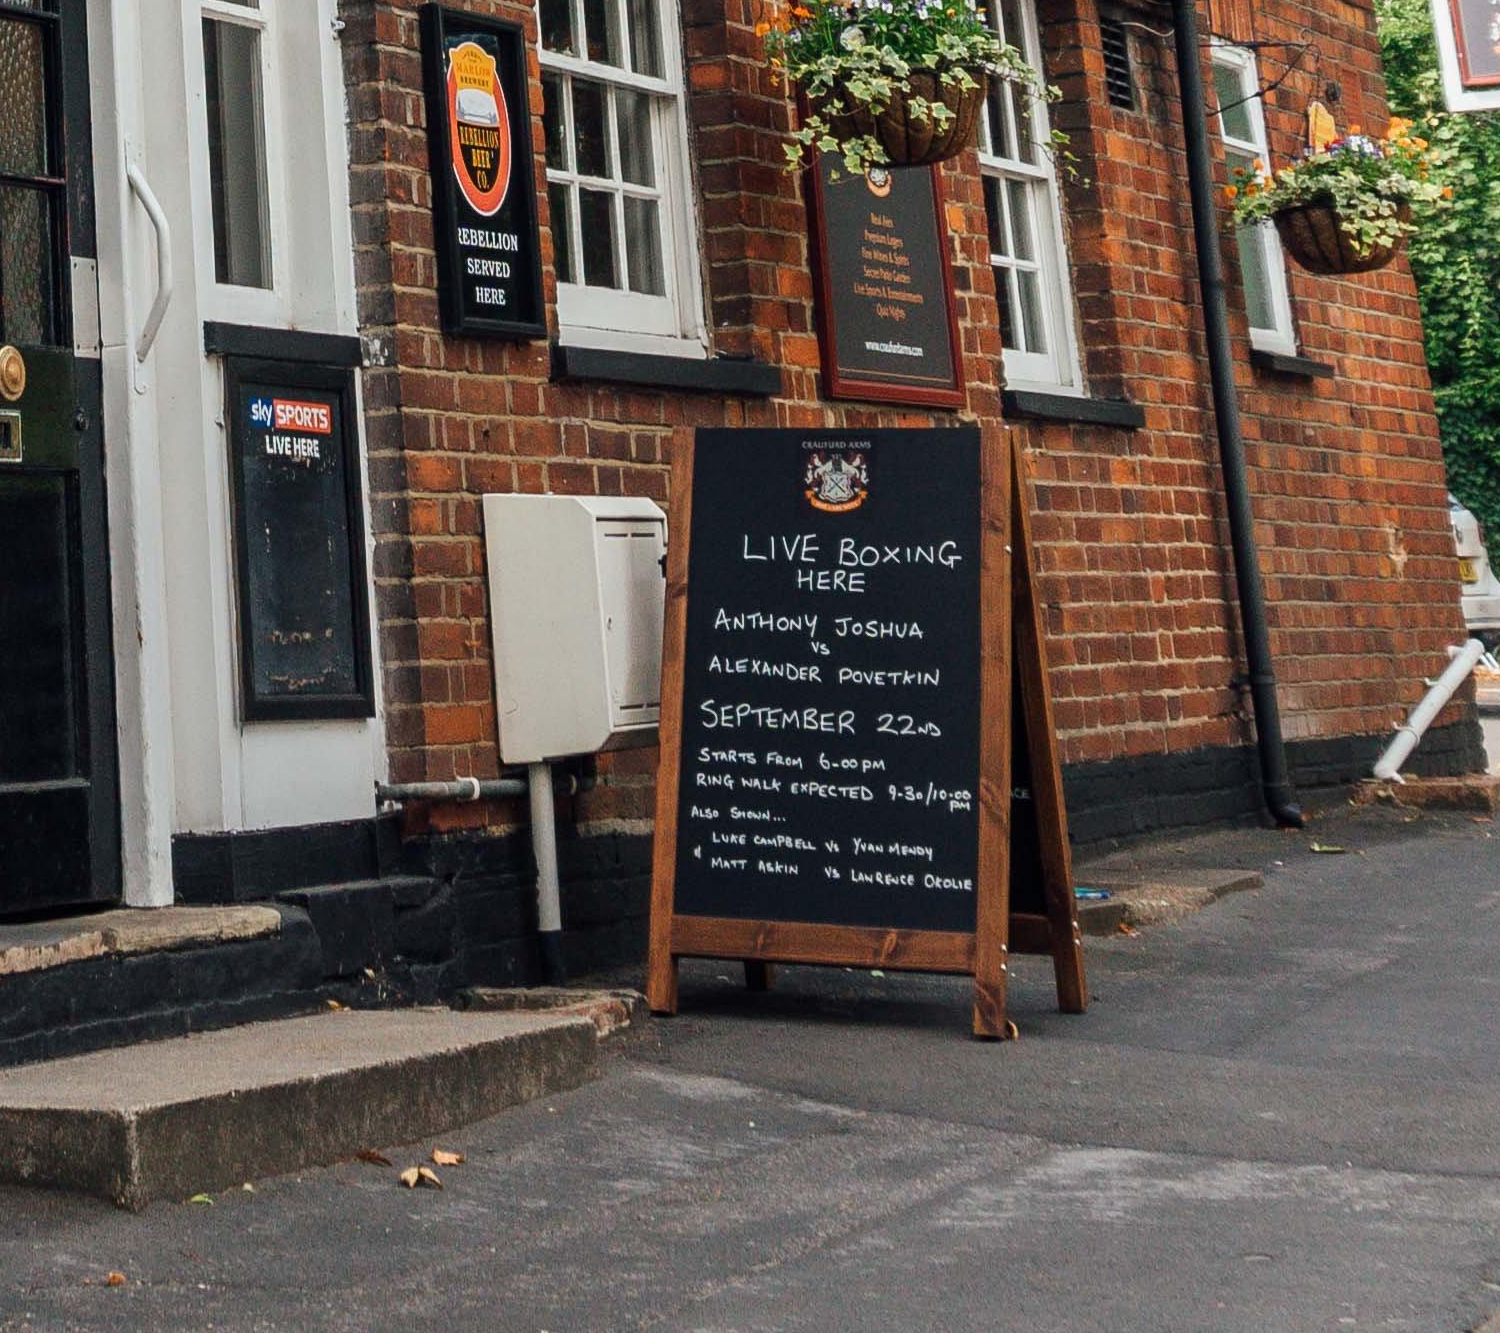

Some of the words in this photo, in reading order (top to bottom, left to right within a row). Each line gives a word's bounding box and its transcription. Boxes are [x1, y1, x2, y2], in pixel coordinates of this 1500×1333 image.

[460, 125, 499, 149] REBELLION
[472, 148, 491, 169] BEER
[467, 257, 510, 278] SERVED
[476, 286, 506, 306] HERE
[252, 399, 272, 427] sky
[276, 405, 328, 429] SPORTS
[265, 435, 292, 455] LIVE
[293, 437, 320, 458] HERE
[743, 533, 820, 562] LIVE
[838, 537, 962, 569] BOXING
[797, 569, 866, 593] HERE
[714, 607, 818, 637] ANTHONY
[834, 617, 924, 639] JOSHUA
[708, 655, 822, 683] ALEXANDER
[838, 667, 940, 686] POVETKIN
[700, 699, 855, 734] SEPTEMBER
[876, 713, 942, 737] 22ND
[698, 747, 757, 765] STARTS
[766, 751, 803, 769] FROM
[696, 773, 735, 790] RING
[741, 777, 782, 792] WALK
[790, 782, 874, 801] EXPECTED
[692, 805, 720, 819] ALSO
[712, 831, 746, 845] LUKE
[754, 835, 816, 851] CAMPBELL
[852, 837, 884, 856] YVAN
[888, 844, 933, 862] MENDY
[712, 857, 748, 870] MATT
[758, 860, 799, 875] ASKIN
[851, 869, 915, 887] LAWRENCE
[924, 875, 972, 891] OKOLIE
